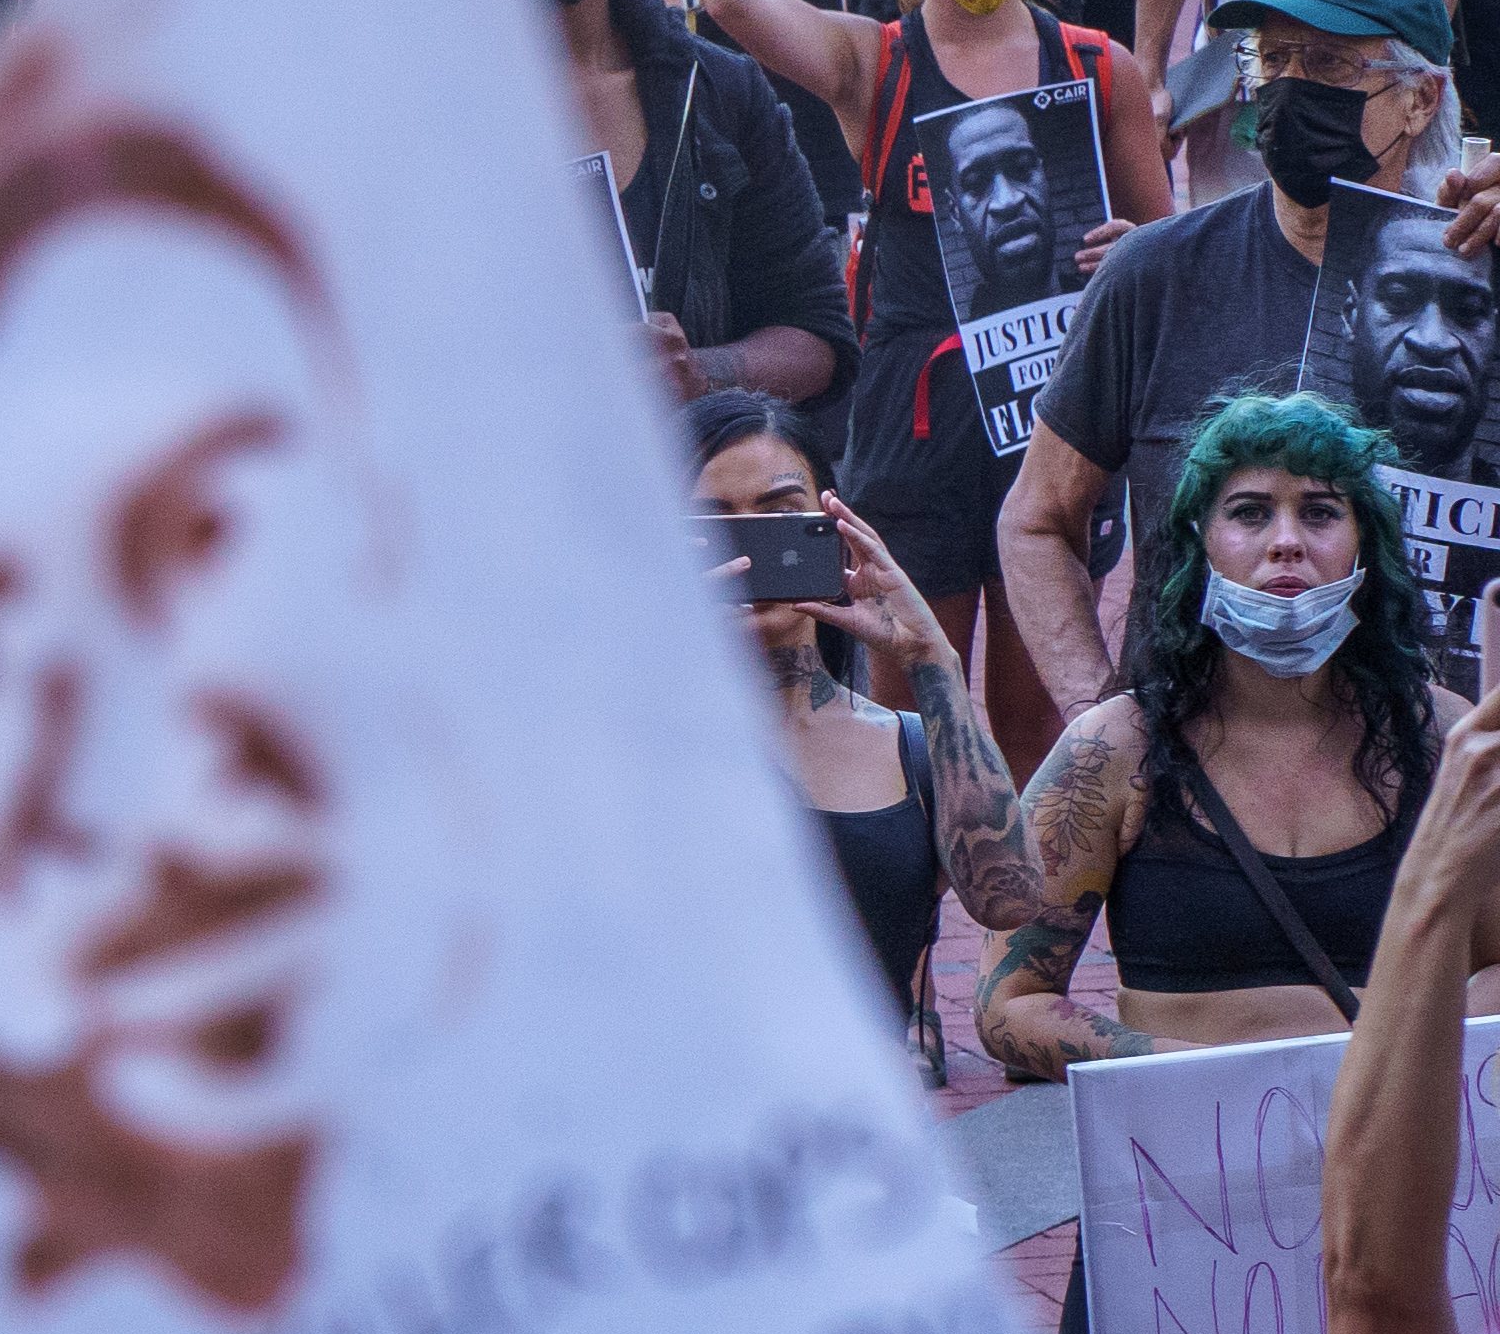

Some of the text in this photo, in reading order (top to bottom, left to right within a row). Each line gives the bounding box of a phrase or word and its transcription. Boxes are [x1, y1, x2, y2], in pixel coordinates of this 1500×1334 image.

[1053, 84, 1088, 102] CAIR
[971, 300, 1078, 370] JUSTIC
[1017, 355, 1056, 386] FOR
[1128, 1083, 1324, 1269] NO
